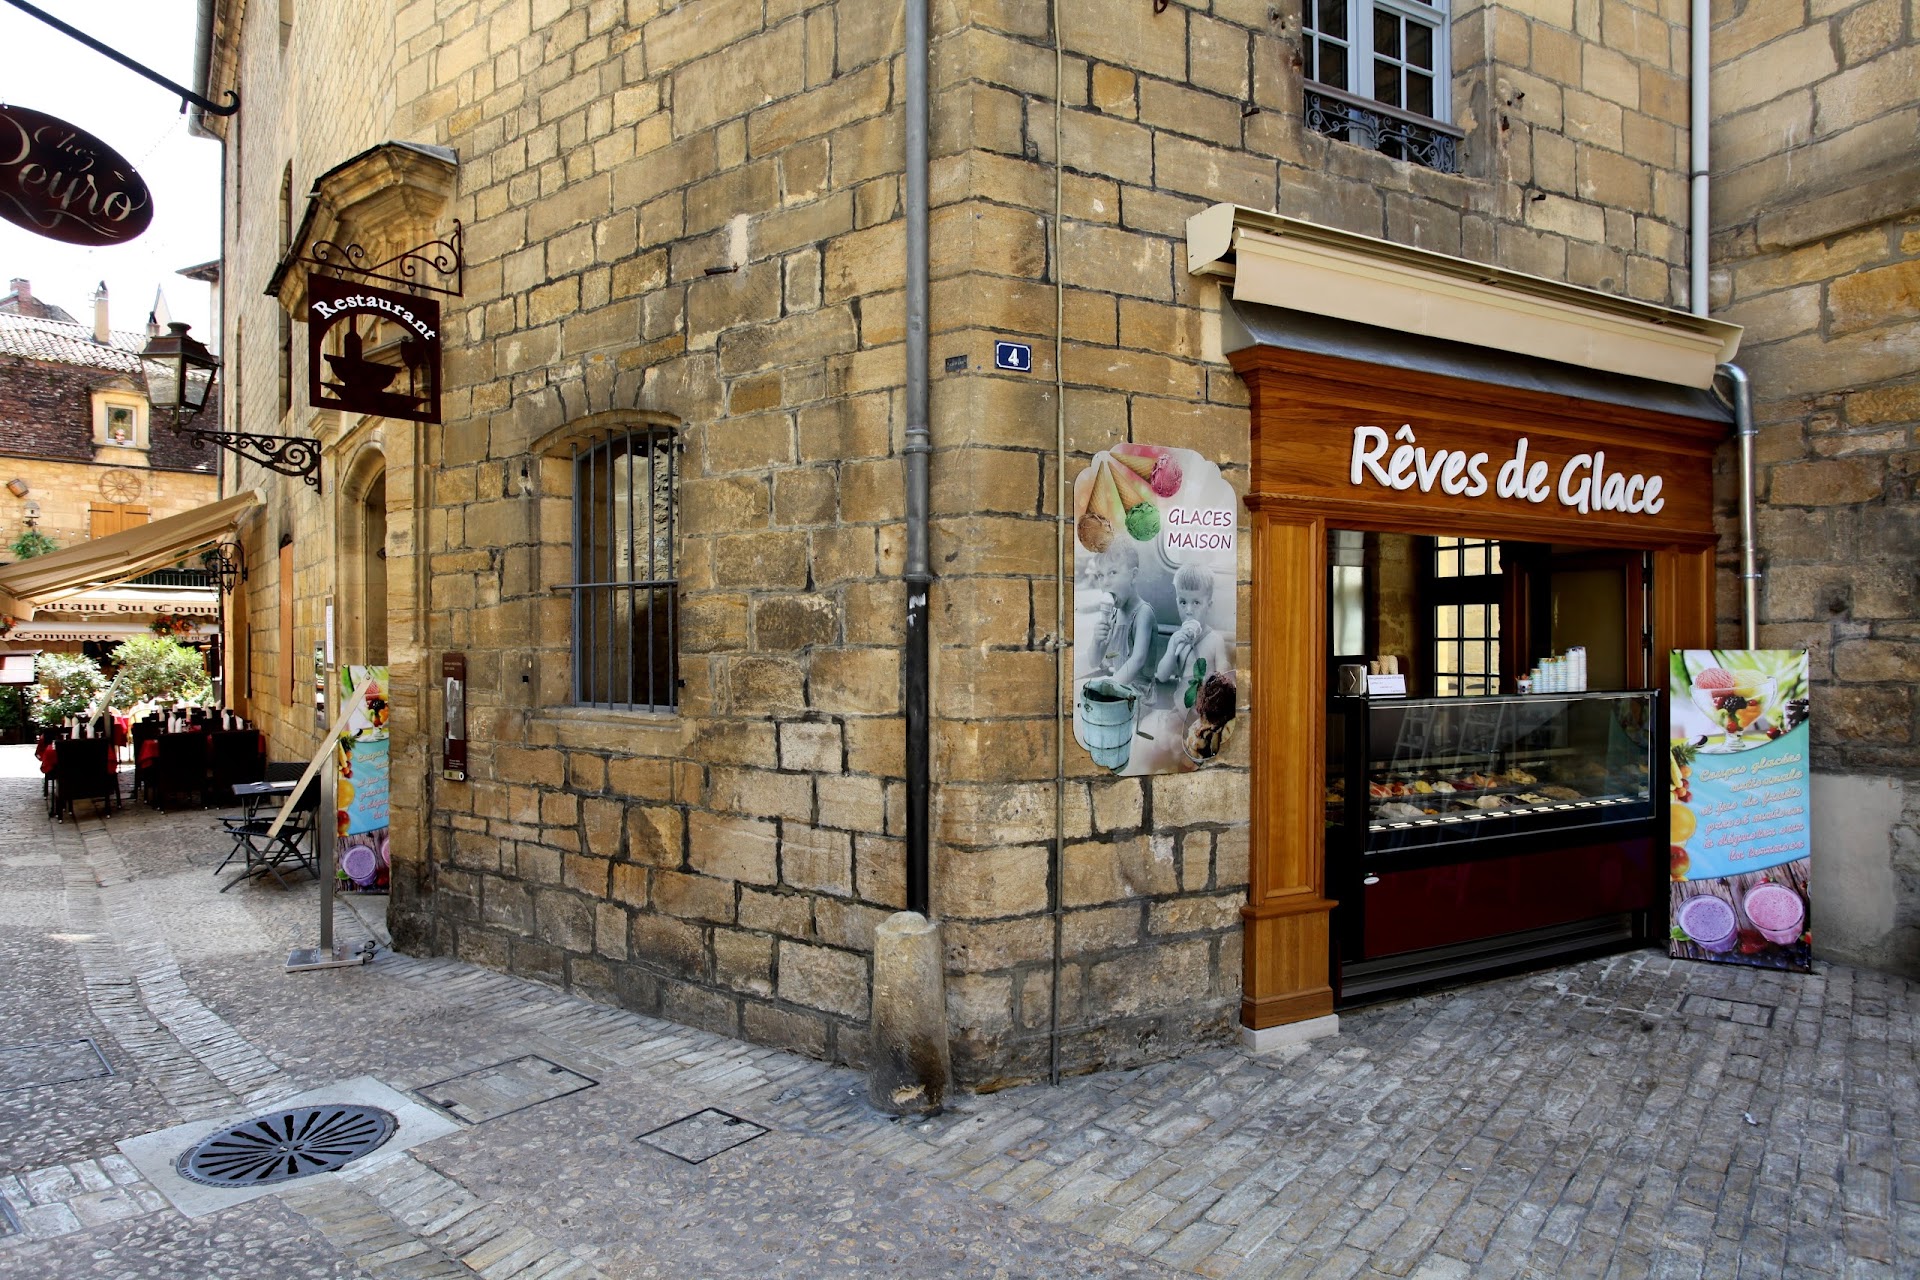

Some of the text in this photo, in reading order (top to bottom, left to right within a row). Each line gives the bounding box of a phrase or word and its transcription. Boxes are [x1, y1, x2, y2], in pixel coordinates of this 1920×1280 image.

[312, 294, 436, 340] Restaurant
[1007, 347, 1020, 367] 4
[1351, 424, 1665, 515] Rêves de Glace
[1168, 508, 1232, 527] GLACES
[1168, 532, 1232, 549] MAISON
[117, 603, 144, 612] du
[14, 631, 112, 640] Commerce
[1700, 764, 1746, 781] Coupes
